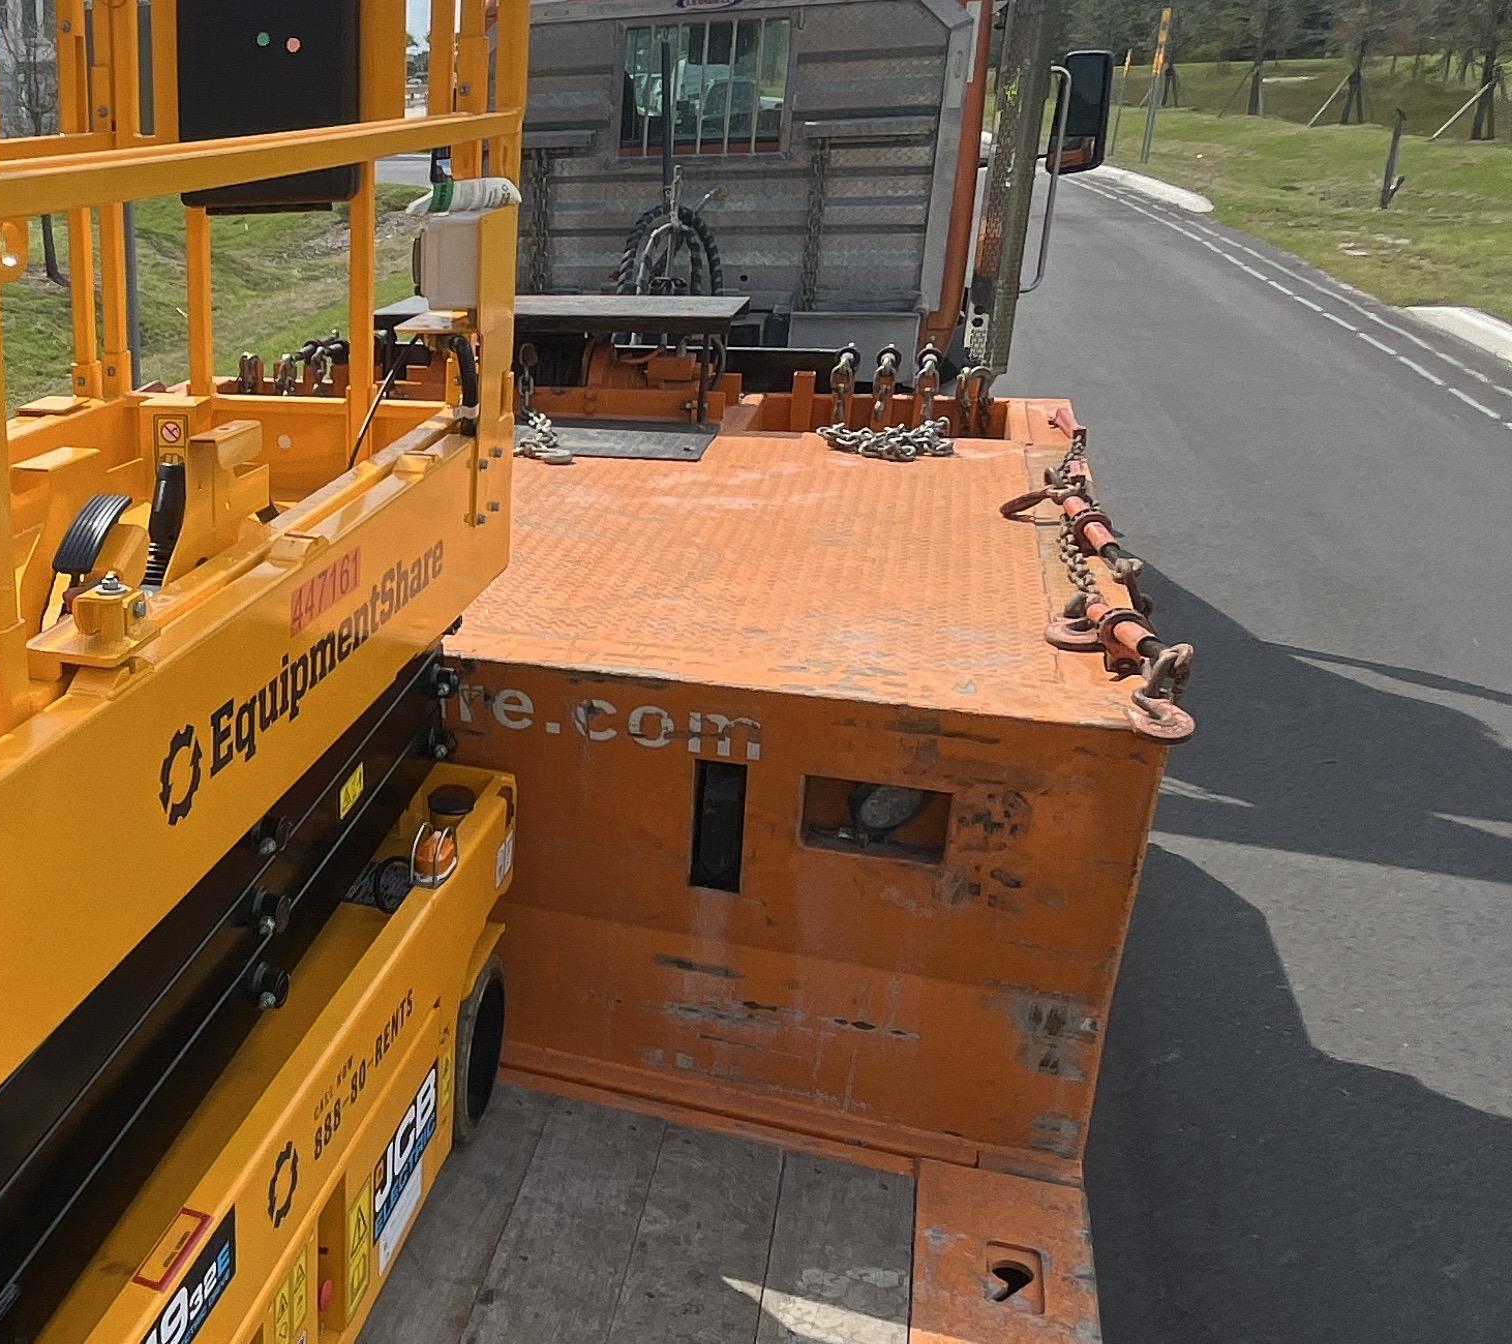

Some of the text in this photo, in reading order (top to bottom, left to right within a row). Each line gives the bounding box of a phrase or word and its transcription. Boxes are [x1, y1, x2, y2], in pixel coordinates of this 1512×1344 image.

[209, 539, 444, 779] EquipmentShare
[290, 546, 361, 632] 447161
[440, 683, 761, 761] re.com
[313, 987, 414, 1161] 888-80-RENTS
[375, 1067, 437, 1213] JCB
